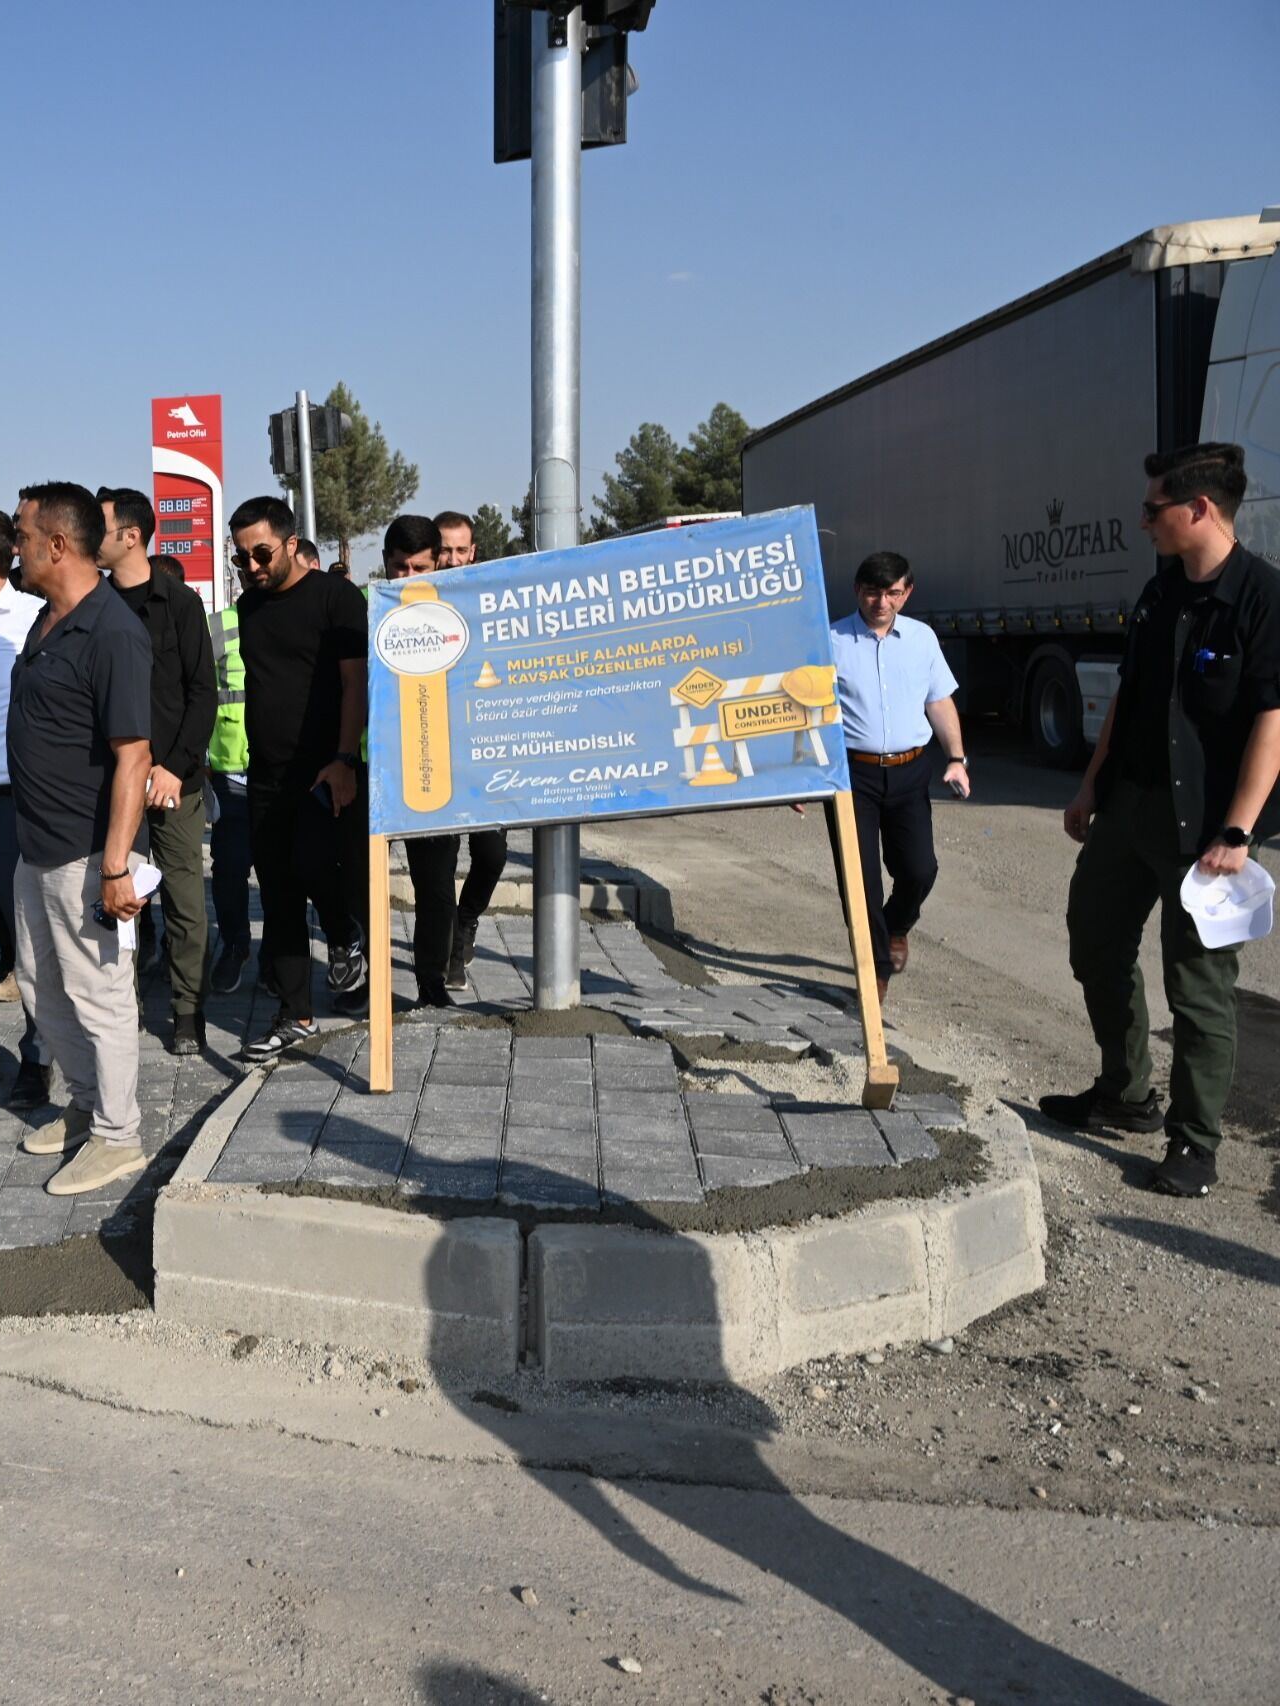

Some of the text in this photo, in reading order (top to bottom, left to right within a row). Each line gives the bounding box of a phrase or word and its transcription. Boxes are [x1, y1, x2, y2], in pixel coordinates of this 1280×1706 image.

[166, 428, 207, 439] Petrol Ofisi
[159, 499, 191, 513] 88.88
[160, 541, 192, 555] 35.09
[1001, 518, 1128, 570] NOROZFAR
[479, 533, 796, 615] BATMAN BELEDİYESİ
[1036, 567, 1084, 584] Trailer
[481, 563, 803, 643] FEN İŞLERİ MÜDÜRLÜĞÜ
[384, 634, 445, 650] BATMAN
[506, 633, 697, 672] MUHTELİF ALANLARDA
[507, 637, 744, 685] KAVŞAK DÜZENLEME YAPIM İŞİ
[475, 679, 662, 711] Çevreye verdiğimiz rahatsızlıktan
[685, 681, 715, 692] UNDER
[475, 703, 579, 723] ötürü özür dileriz
[735, 700, 794, 720] UNDER
[734, 714, 798, 730] CONSTRUCTION
[522, 730, 556, 740] FİRMA:
[471, 732, 637, 761] BOZ MÜHENDİSLİK
[485, 760, 670, 793] Ekrem CANALP
[543, 783, 612, 796] Batman Valisi
[531, 796, 573, 806] Belediye
